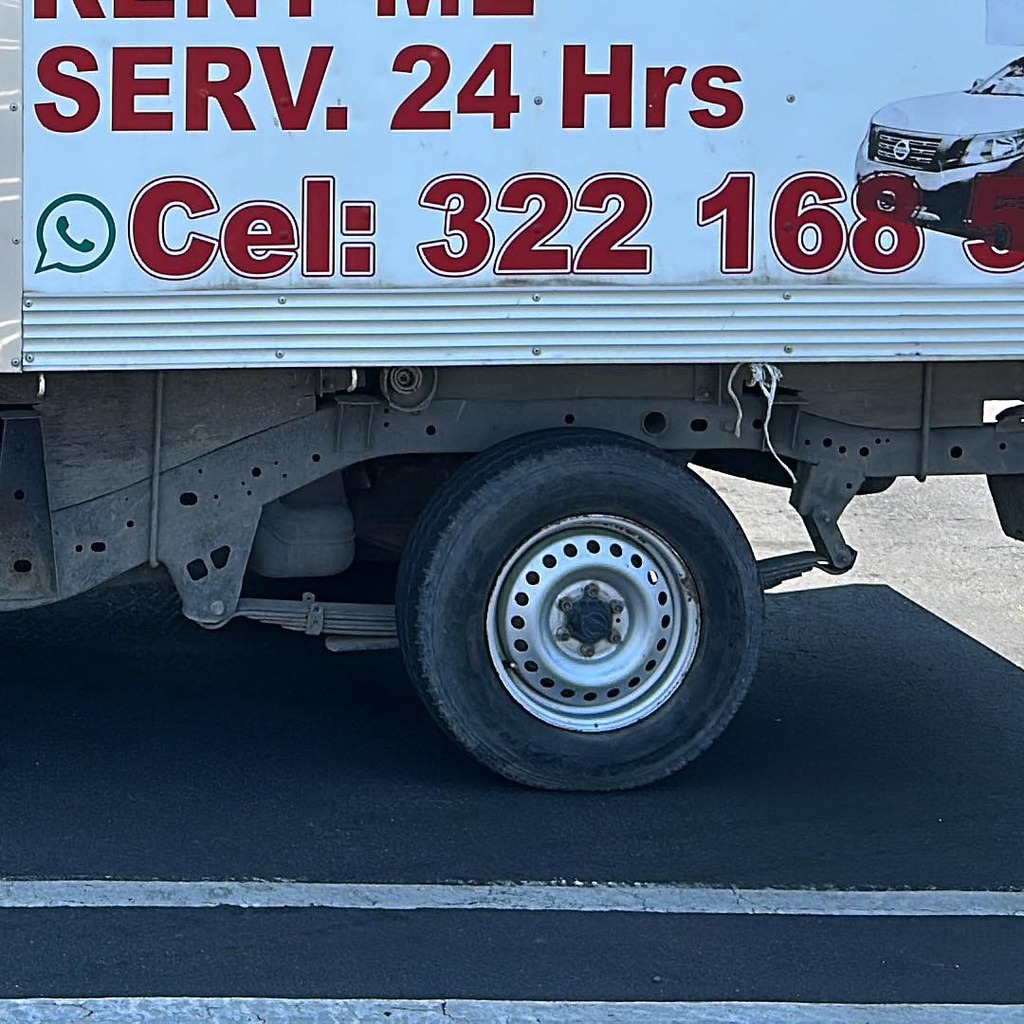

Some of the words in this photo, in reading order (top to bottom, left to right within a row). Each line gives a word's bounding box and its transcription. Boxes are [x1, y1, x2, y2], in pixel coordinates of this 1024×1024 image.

[33, 45, 349, 133] SERV.
[390, 43, 520, 131] 24
[561, 43, 744, 130] Hrs
[128, 176, 376, 280] Cel:
[416, 173, 653, 276] 322
[696, 172, 925, 274] 168
